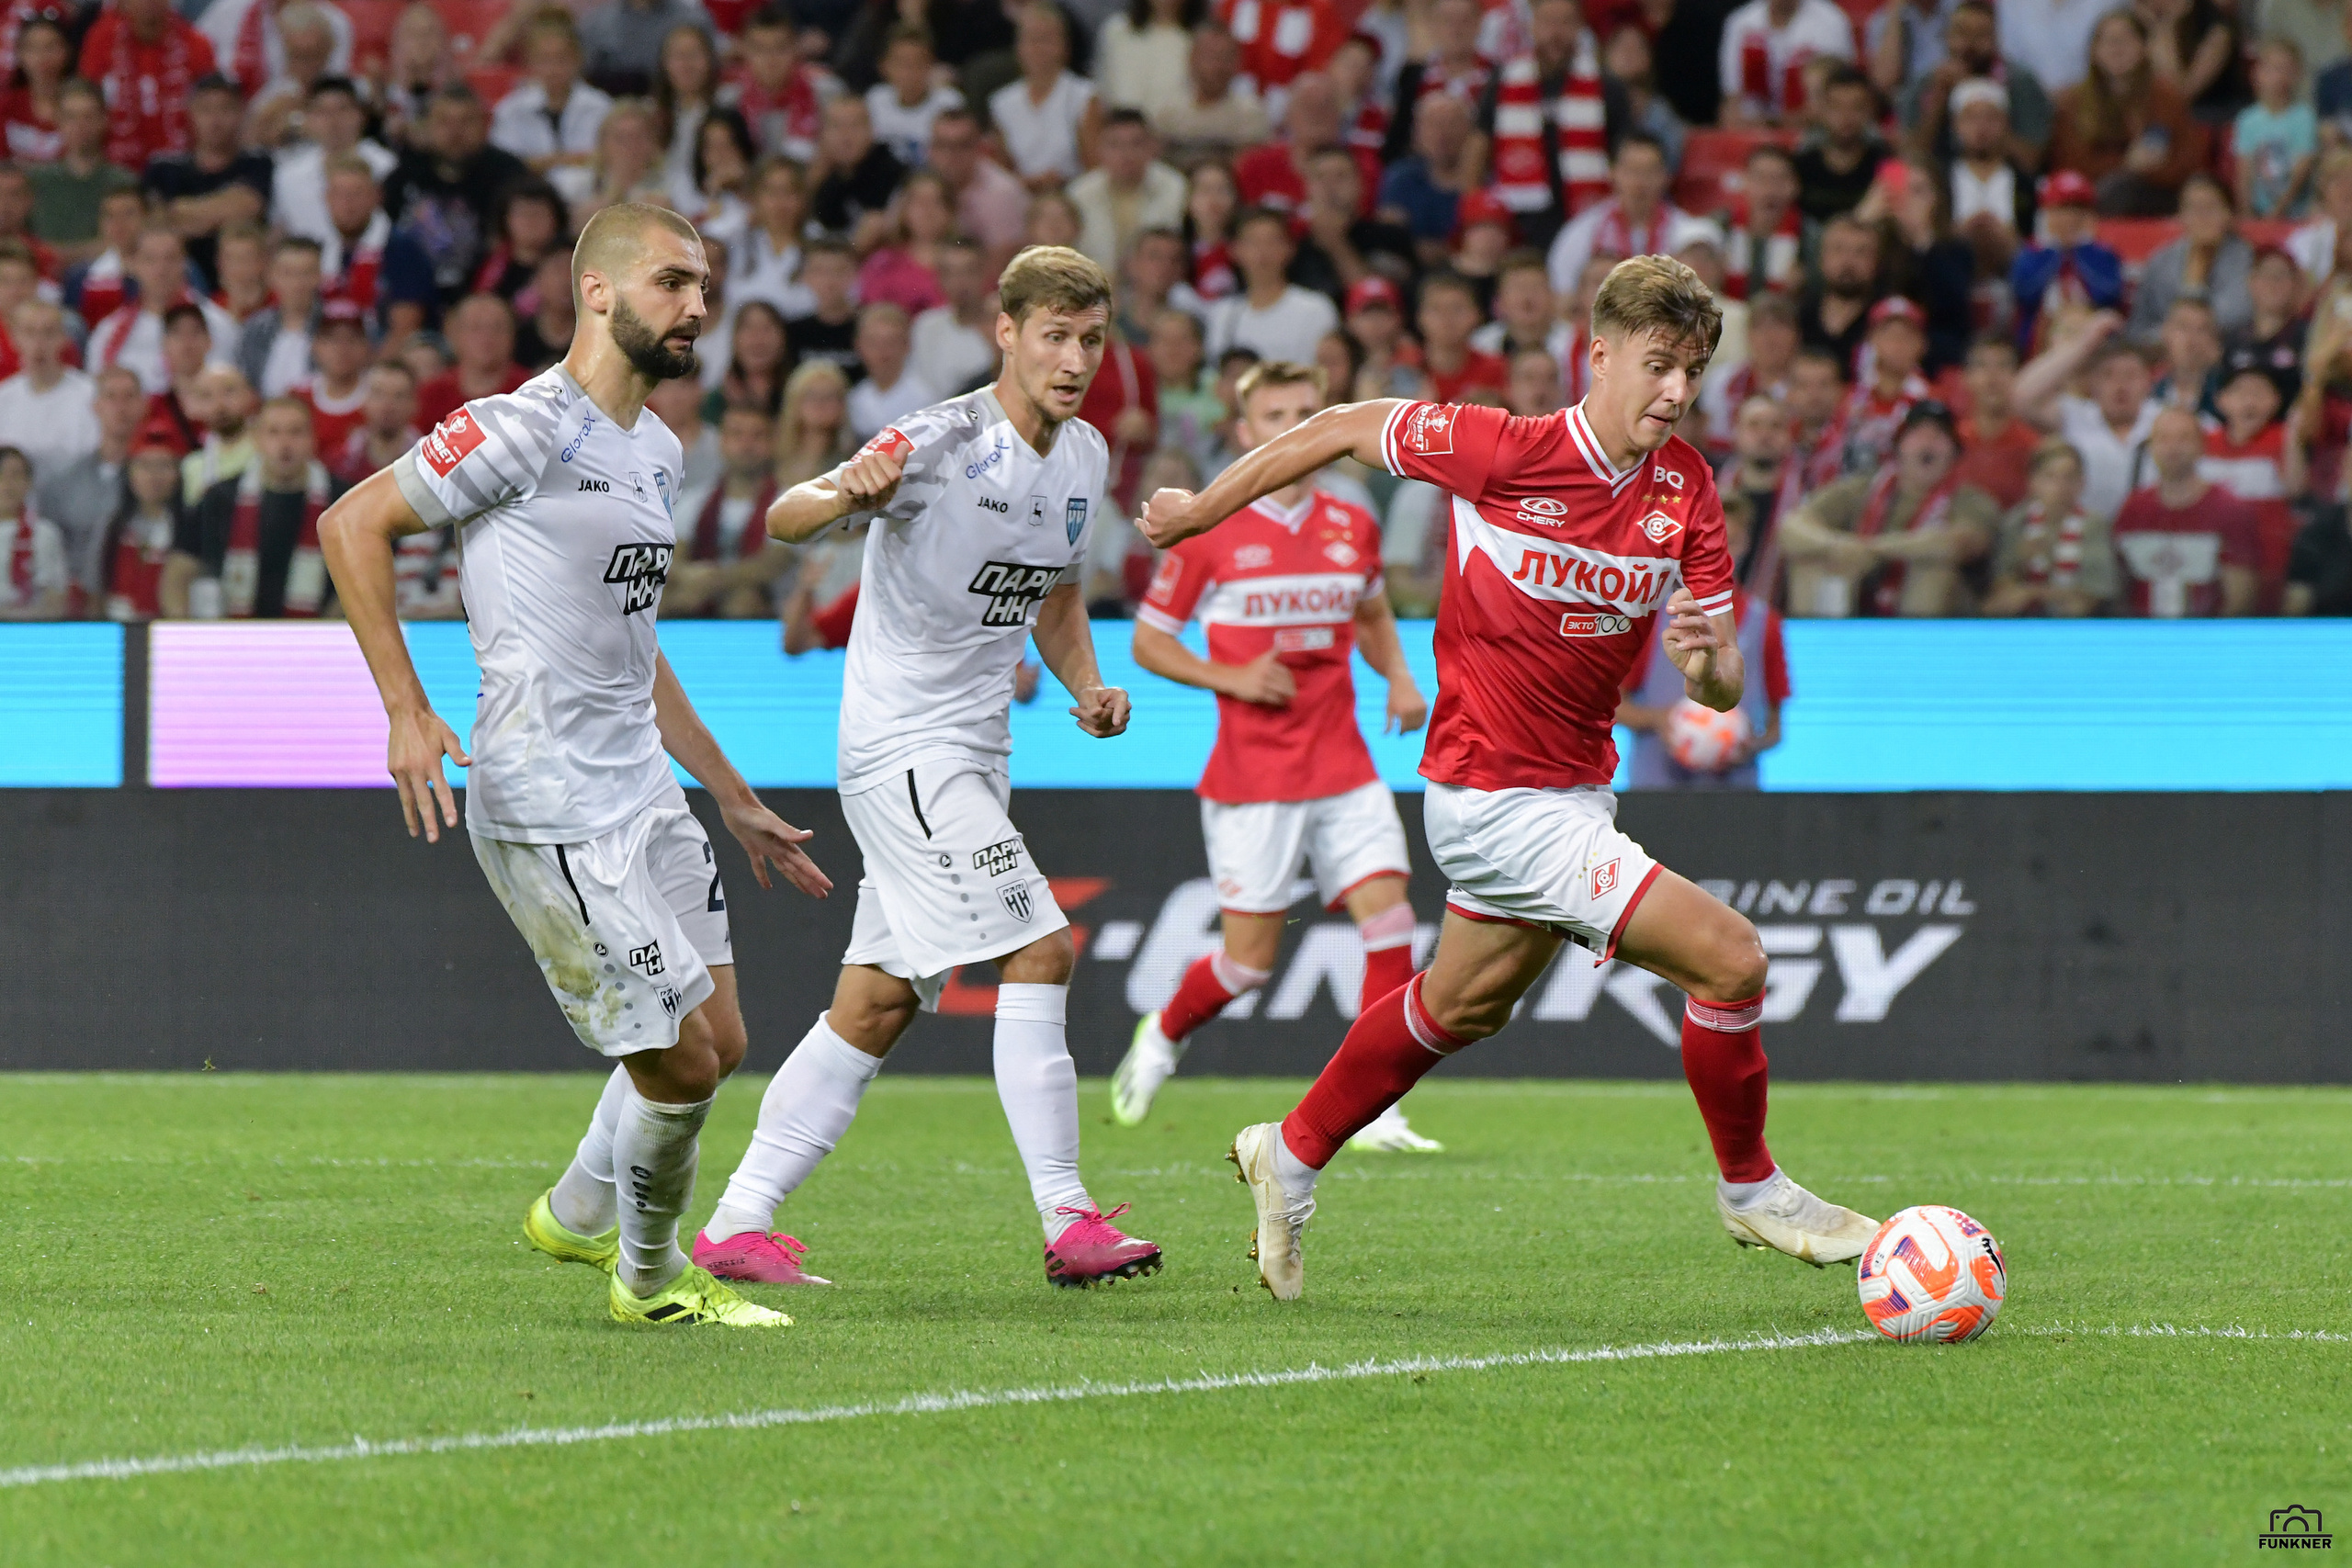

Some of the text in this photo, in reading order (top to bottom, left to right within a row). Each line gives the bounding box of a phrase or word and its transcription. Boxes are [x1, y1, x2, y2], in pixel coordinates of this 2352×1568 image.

[578, 479, 610, 492] JAKO
[1655, 466, 1684, 490] BQ
[978, 496, 1009, 513] JAKO
[1516, 511, 1566, 528] CHERY
[973, 564, 1063, 597] ПАРИ
[986, 595, 1032, 623] НН
[974, 839, 1023, 867] ПАРИ
[990, 854, 1017, 876] НН
[1865, 879, 1978, 915] OIL
